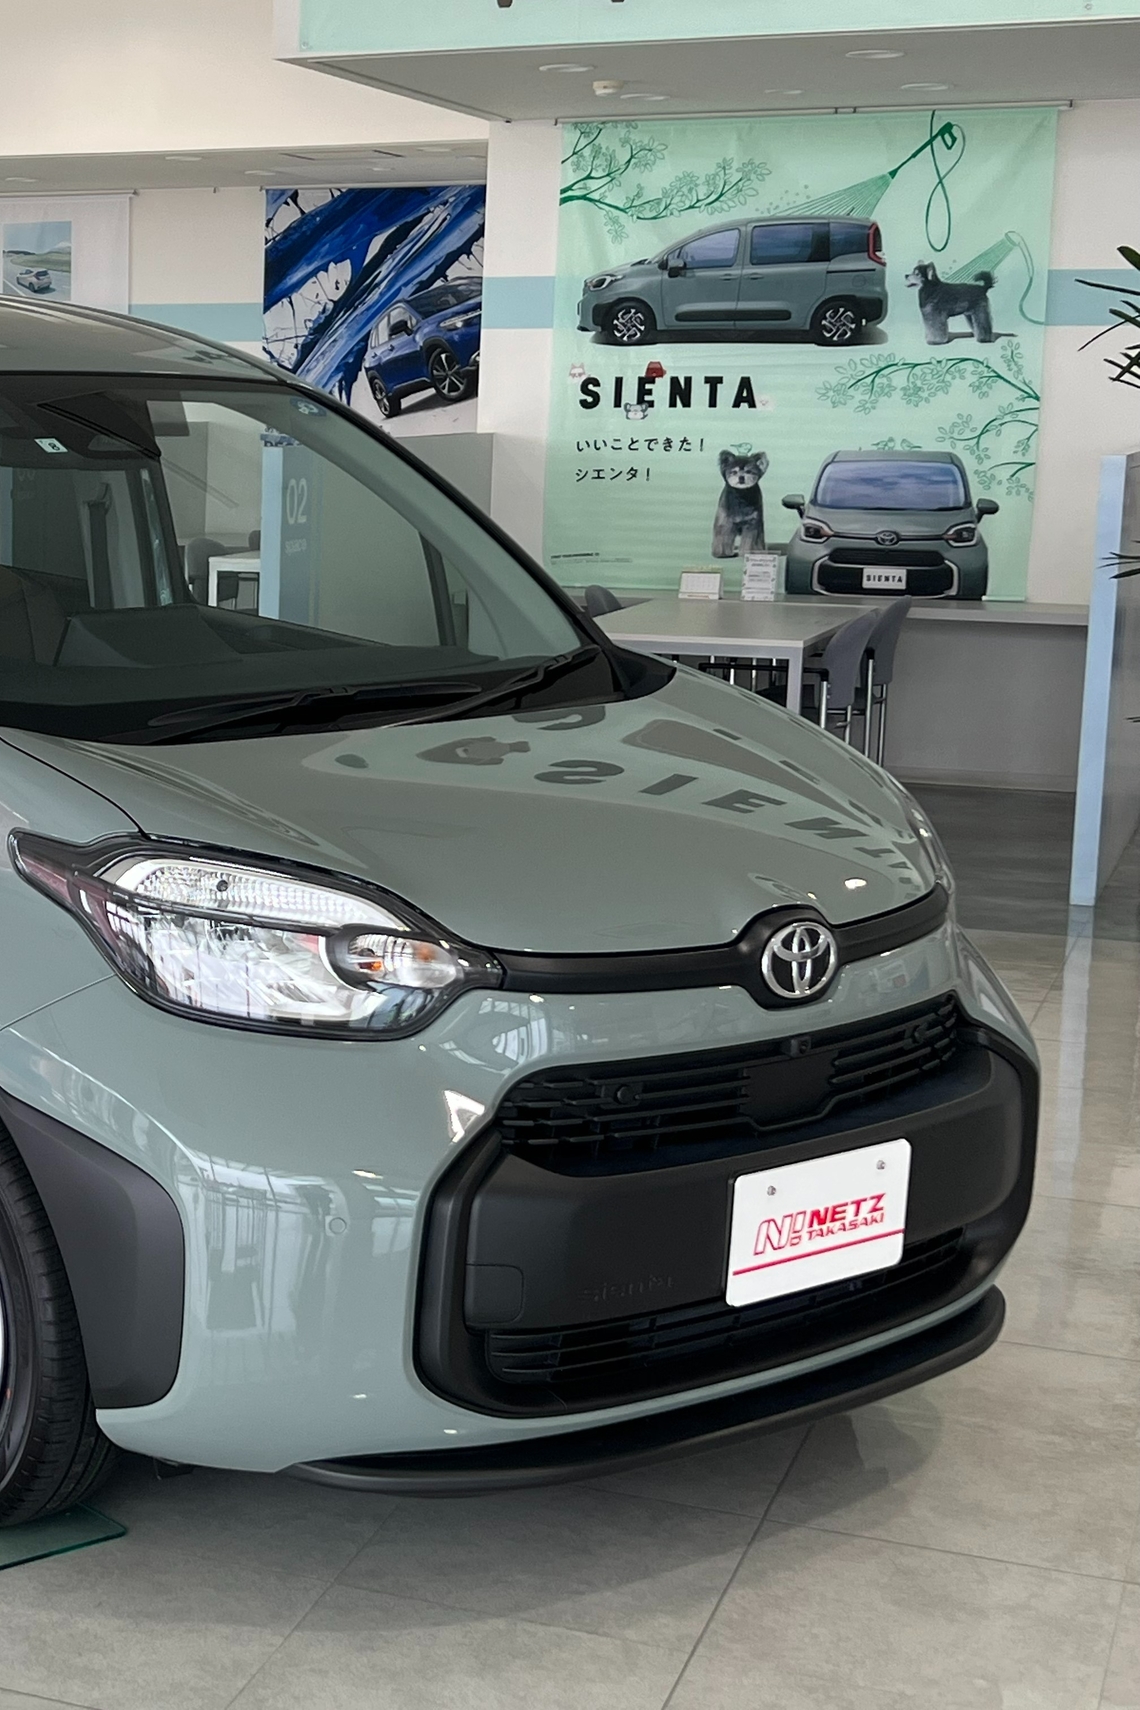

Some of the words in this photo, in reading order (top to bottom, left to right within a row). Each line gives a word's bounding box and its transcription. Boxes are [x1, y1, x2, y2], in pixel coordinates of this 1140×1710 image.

[579, 376, 757, 410] SIENTA
[576, 437, 705, 453] いいことできた！
[575, 466, 652, 482] シエンタ！
[285, 478, 308, 525] 02
[866, 574, 903, 583] SIENTA
[808, 1193, 886, 1229] NETZ
[807, 1212, 885, 1240] TAKASAKI
